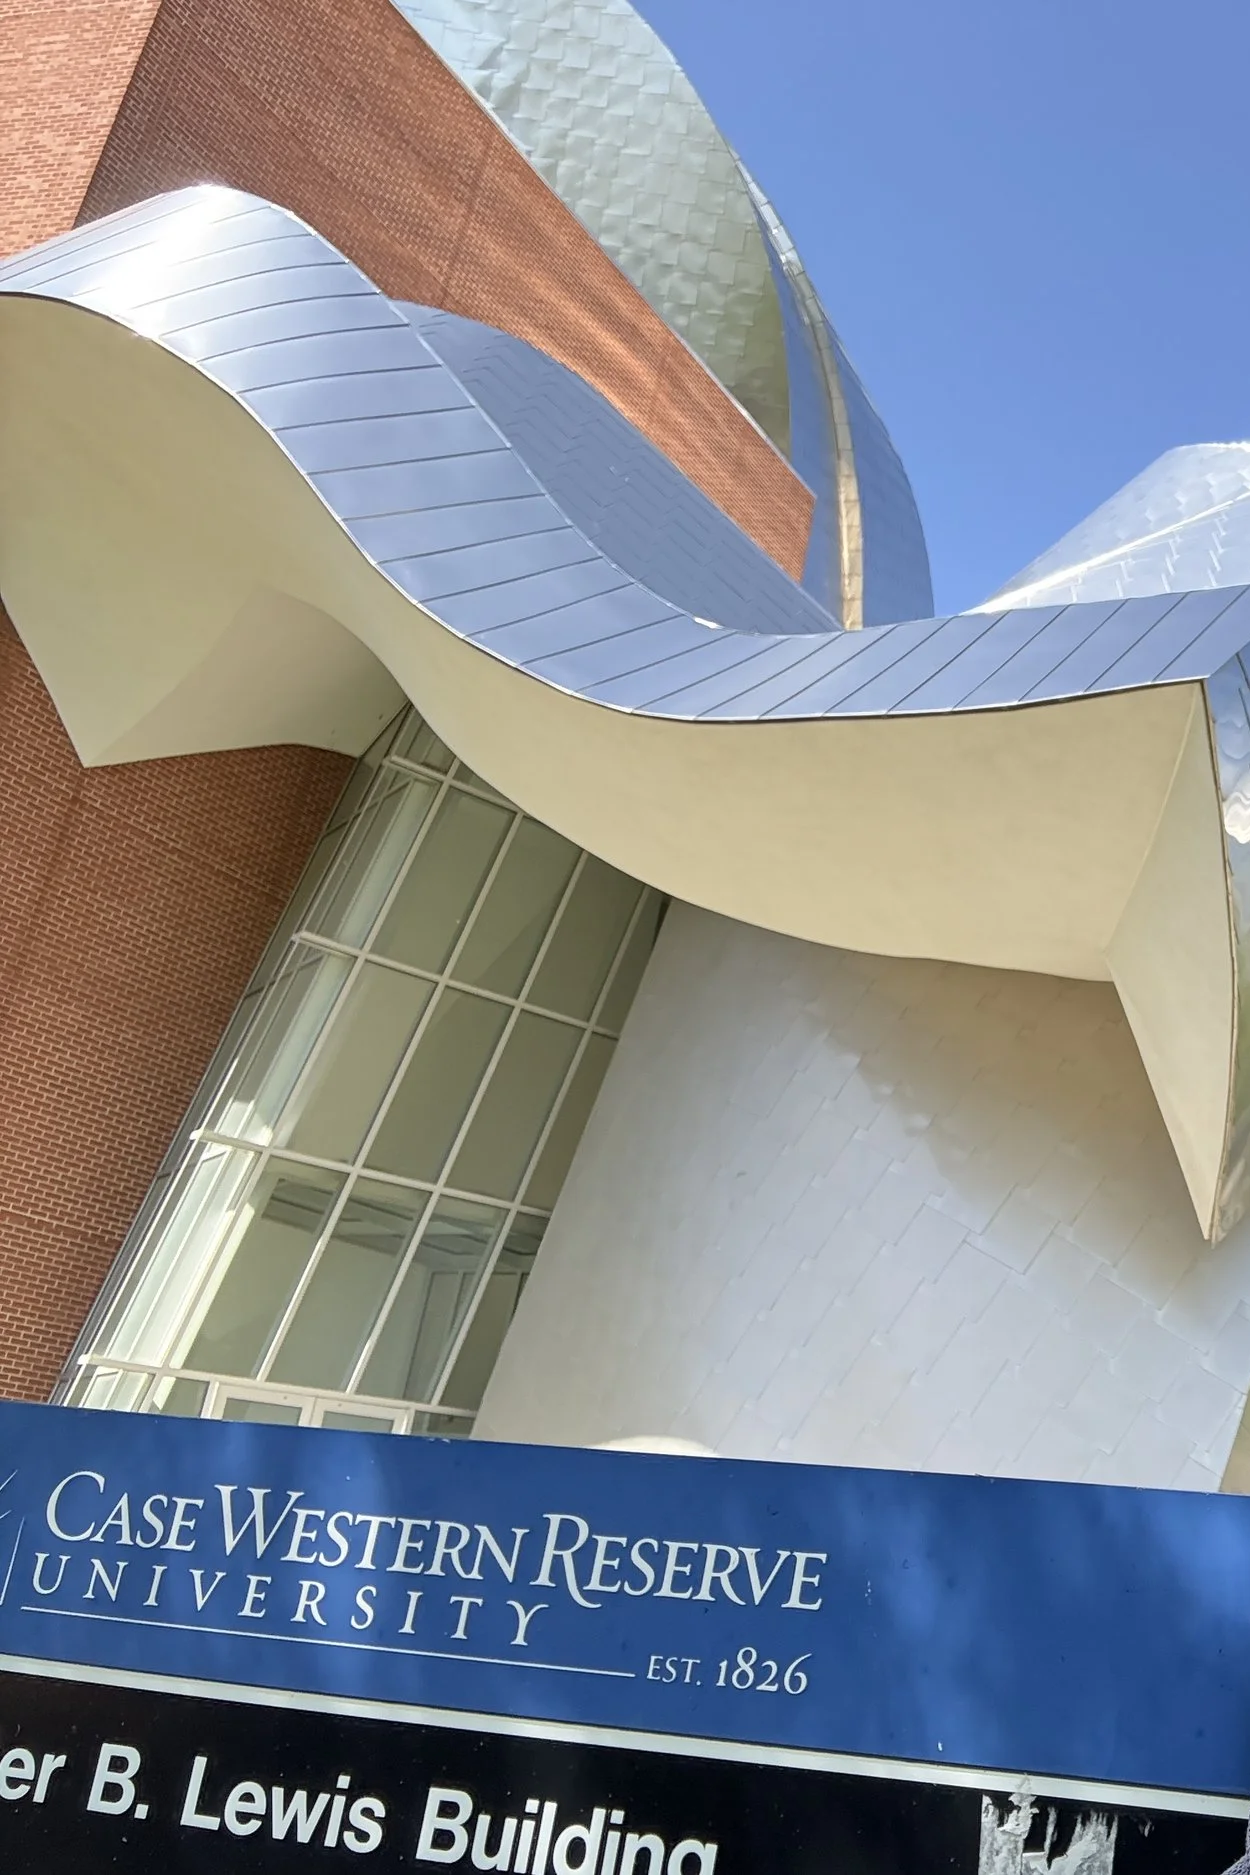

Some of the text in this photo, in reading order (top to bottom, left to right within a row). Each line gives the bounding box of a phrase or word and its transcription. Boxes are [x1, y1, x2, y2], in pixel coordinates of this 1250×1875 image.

[46, 1470, 827, 1610] CASE WESTERN RESERVE
[32, 1552, 549, 1646] UNIVERSITY
[646, 1646, 812, 1695] EST. 1826
[86, 1742, 149, 1820] B.
[180, 1755, 386, 1854] Lewis
